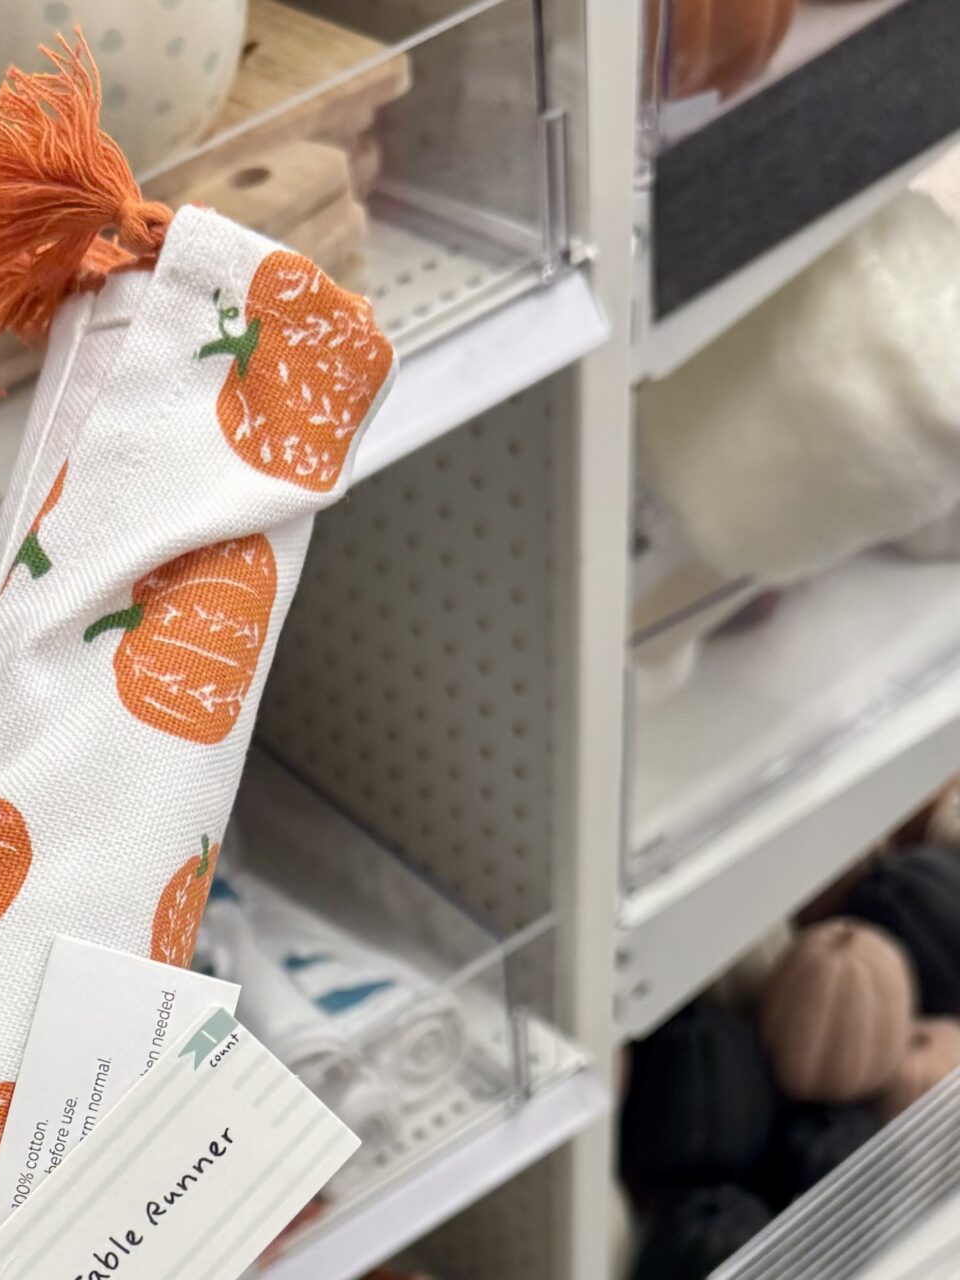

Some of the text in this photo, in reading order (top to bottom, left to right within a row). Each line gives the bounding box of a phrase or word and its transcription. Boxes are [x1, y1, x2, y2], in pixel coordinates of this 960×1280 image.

[151, 989, 177, 1047] needed.
[209, 1033, 240, 1068] count
[61, 1097, 79, 1124] use.
[87, 1057, 113, 1112] normal.
[25, 1119, 49, 1170] cotton.
[145, 1126, 236, 1226] Runner
